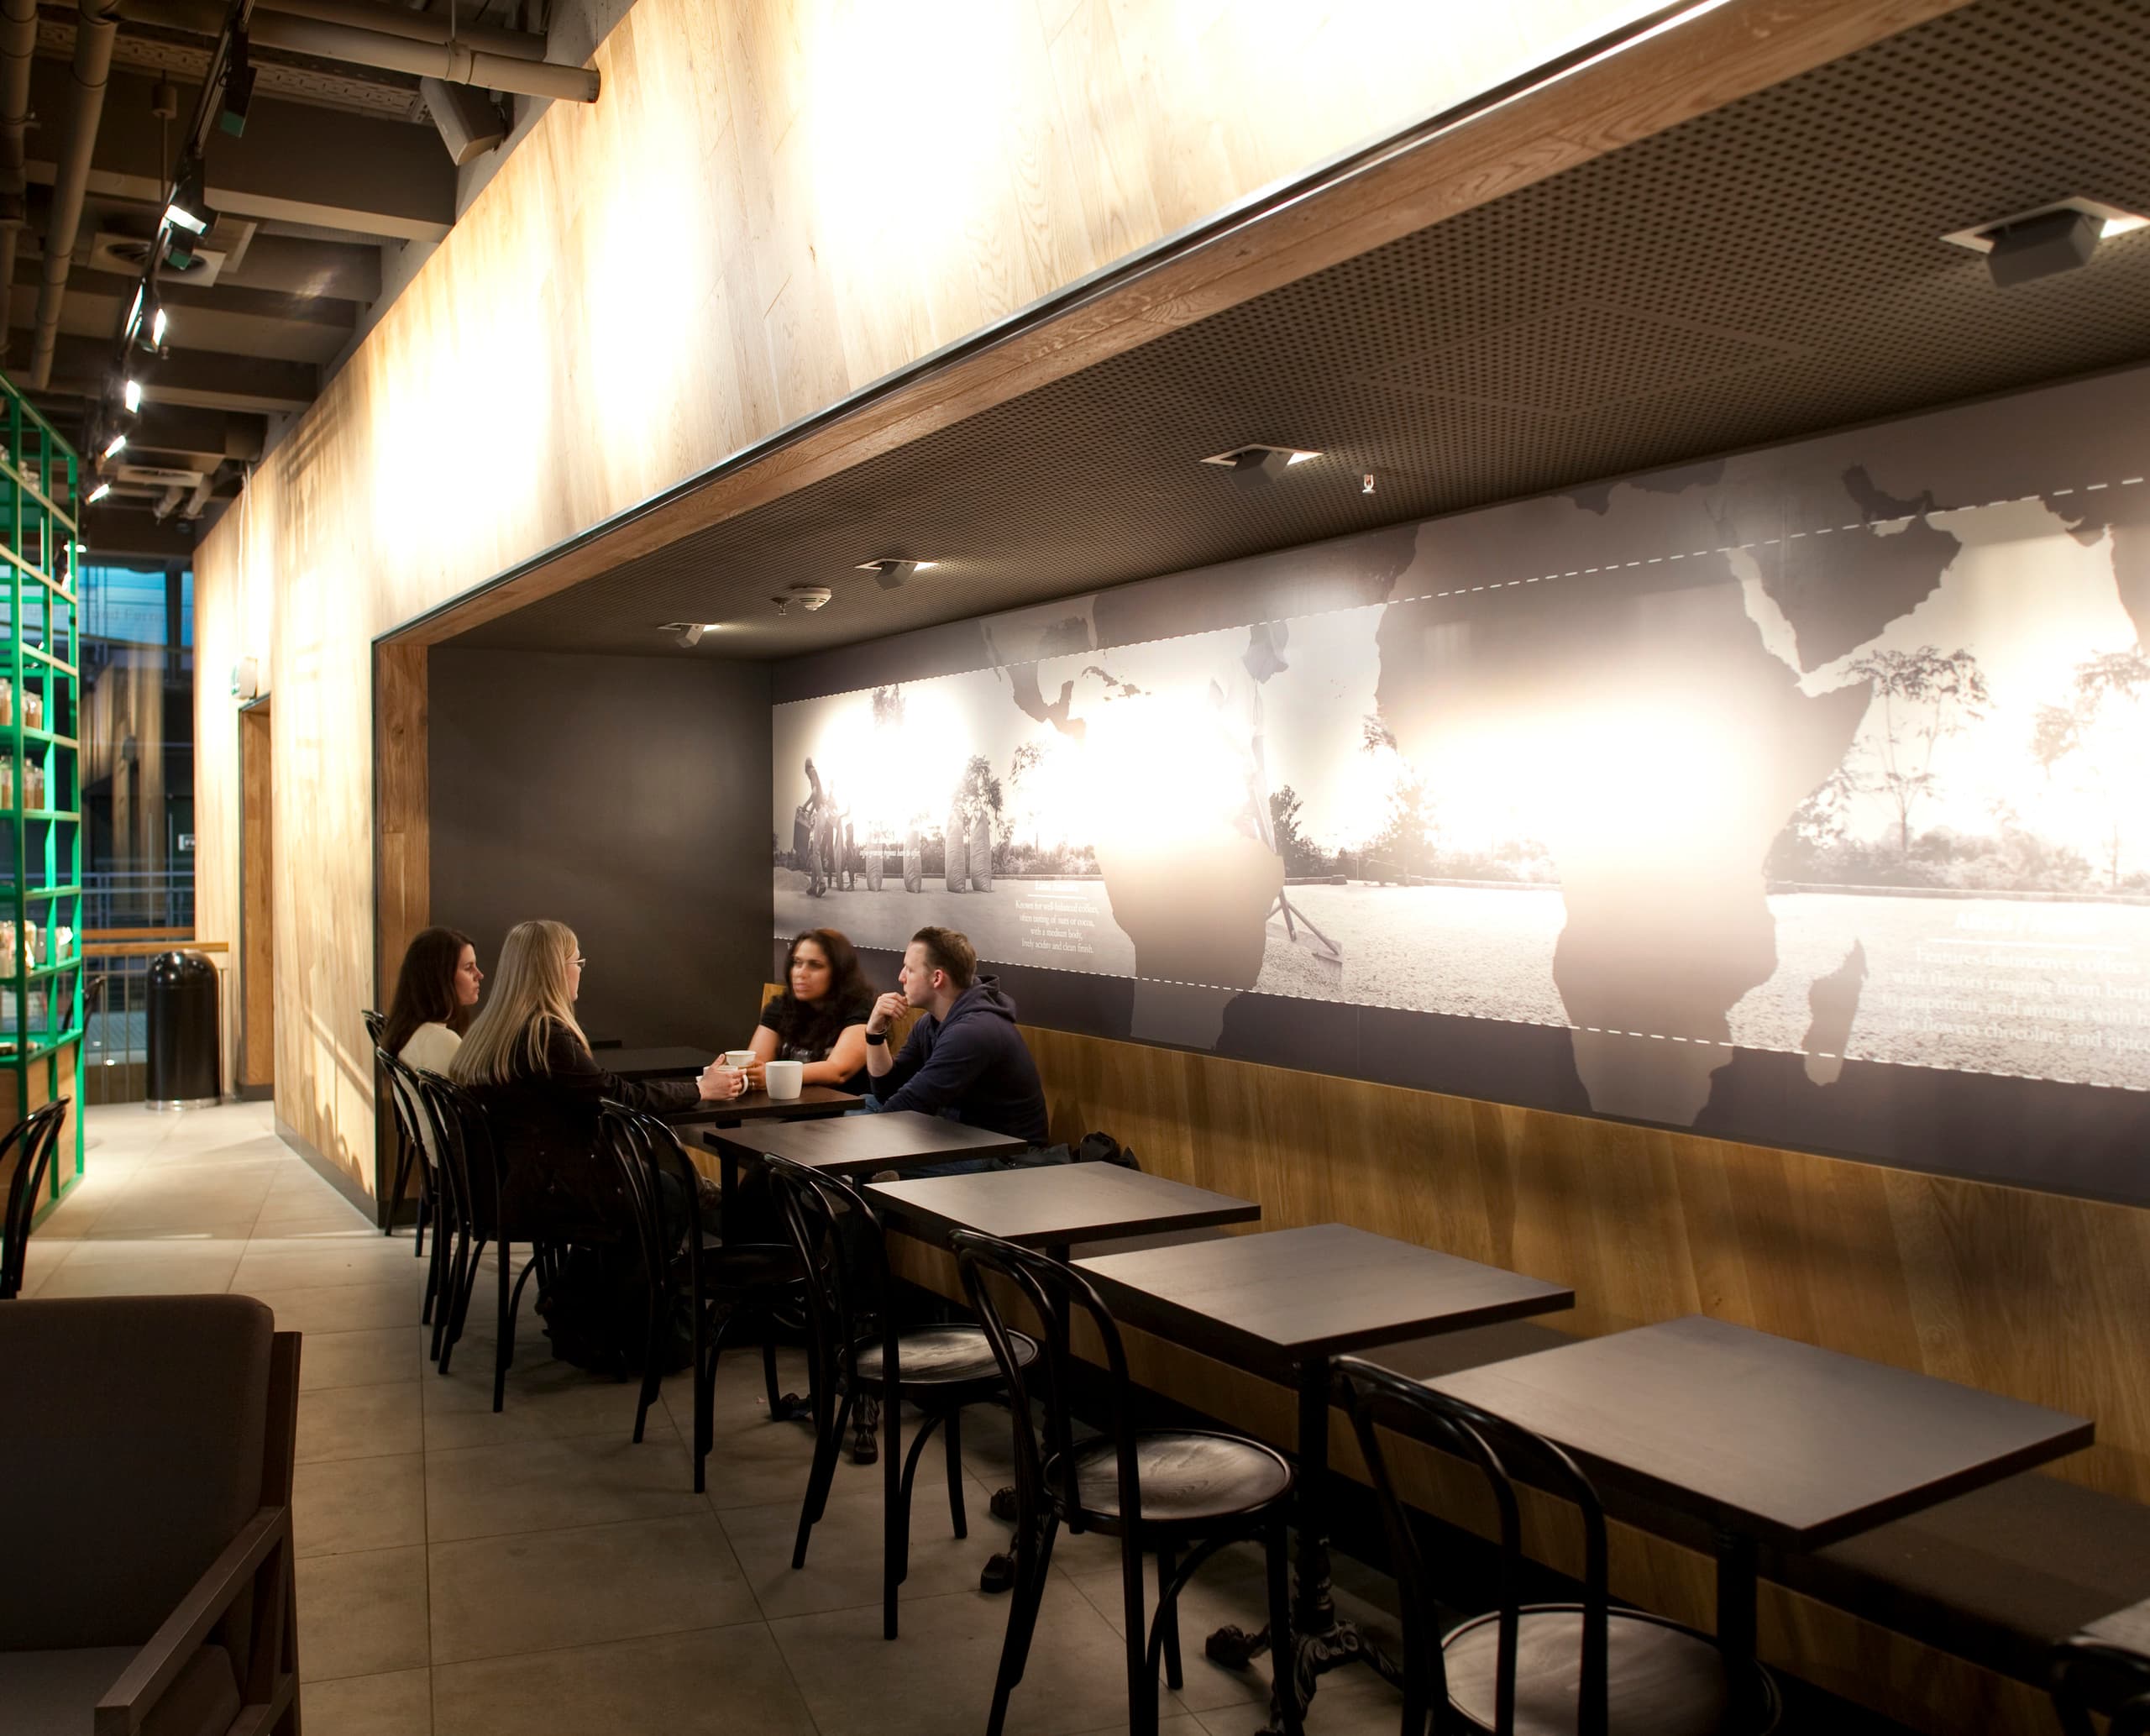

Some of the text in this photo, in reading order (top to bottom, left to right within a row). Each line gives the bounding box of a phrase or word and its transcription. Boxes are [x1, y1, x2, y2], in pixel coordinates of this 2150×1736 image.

[1015, 900, 1034, 909] Known
[1051, 915, 1057, 924] of
[1030, 927, 1041, 936] with
[1046, 928, 1067, 937] medium
[1051, 941, 1062, 951] and
[1063, 941, 1076, 952] clean
[2056, 978, 2100, 998] from
[1987, 999, 2017, 1016] and
[2089, 1008, 2131, 1025] with
[1898, 1015, 1917, 1030] of
[1922, 1015, 1980, 1035] flowers
[1984, 1021, 2063, 1045] chocolate
[2069, 1030, 2102, 1047] and
